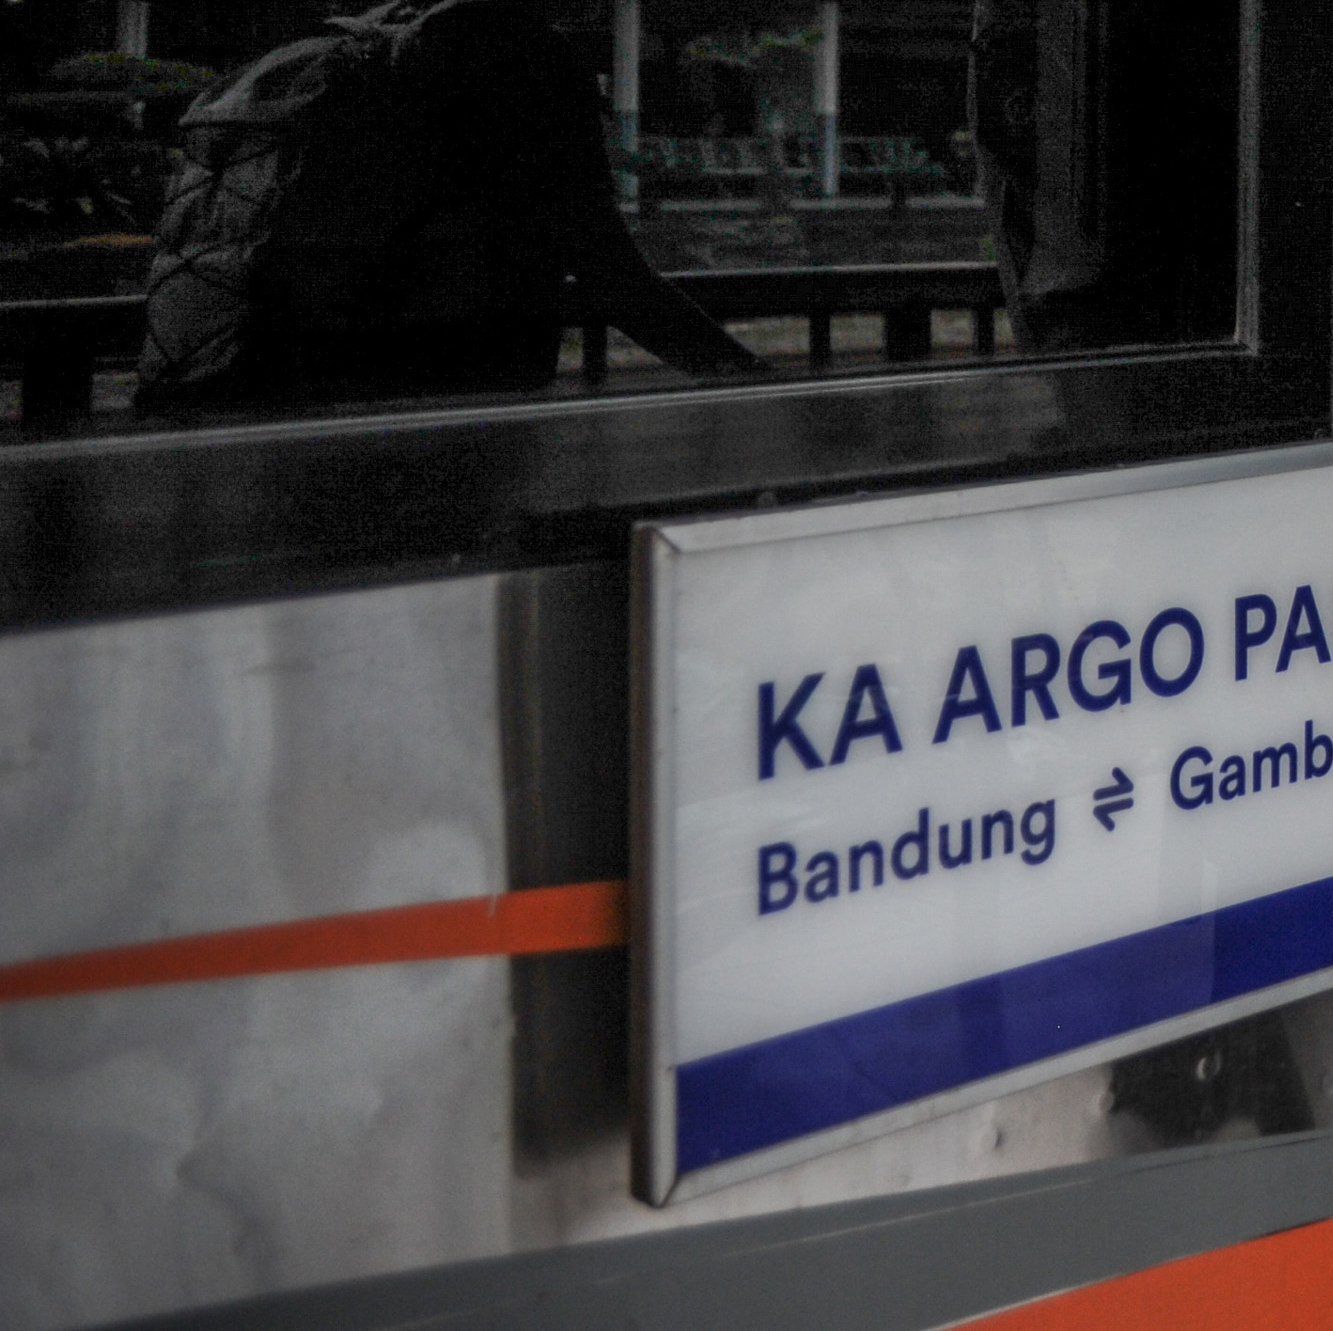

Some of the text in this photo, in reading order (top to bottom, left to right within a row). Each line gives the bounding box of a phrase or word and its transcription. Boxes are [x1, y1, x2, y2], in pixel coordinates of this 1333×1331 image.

[758, 663, 904, 781] KA
[932, 606, 1205, 746] ARGO
[757, 799, 1056, 916] Bandung
